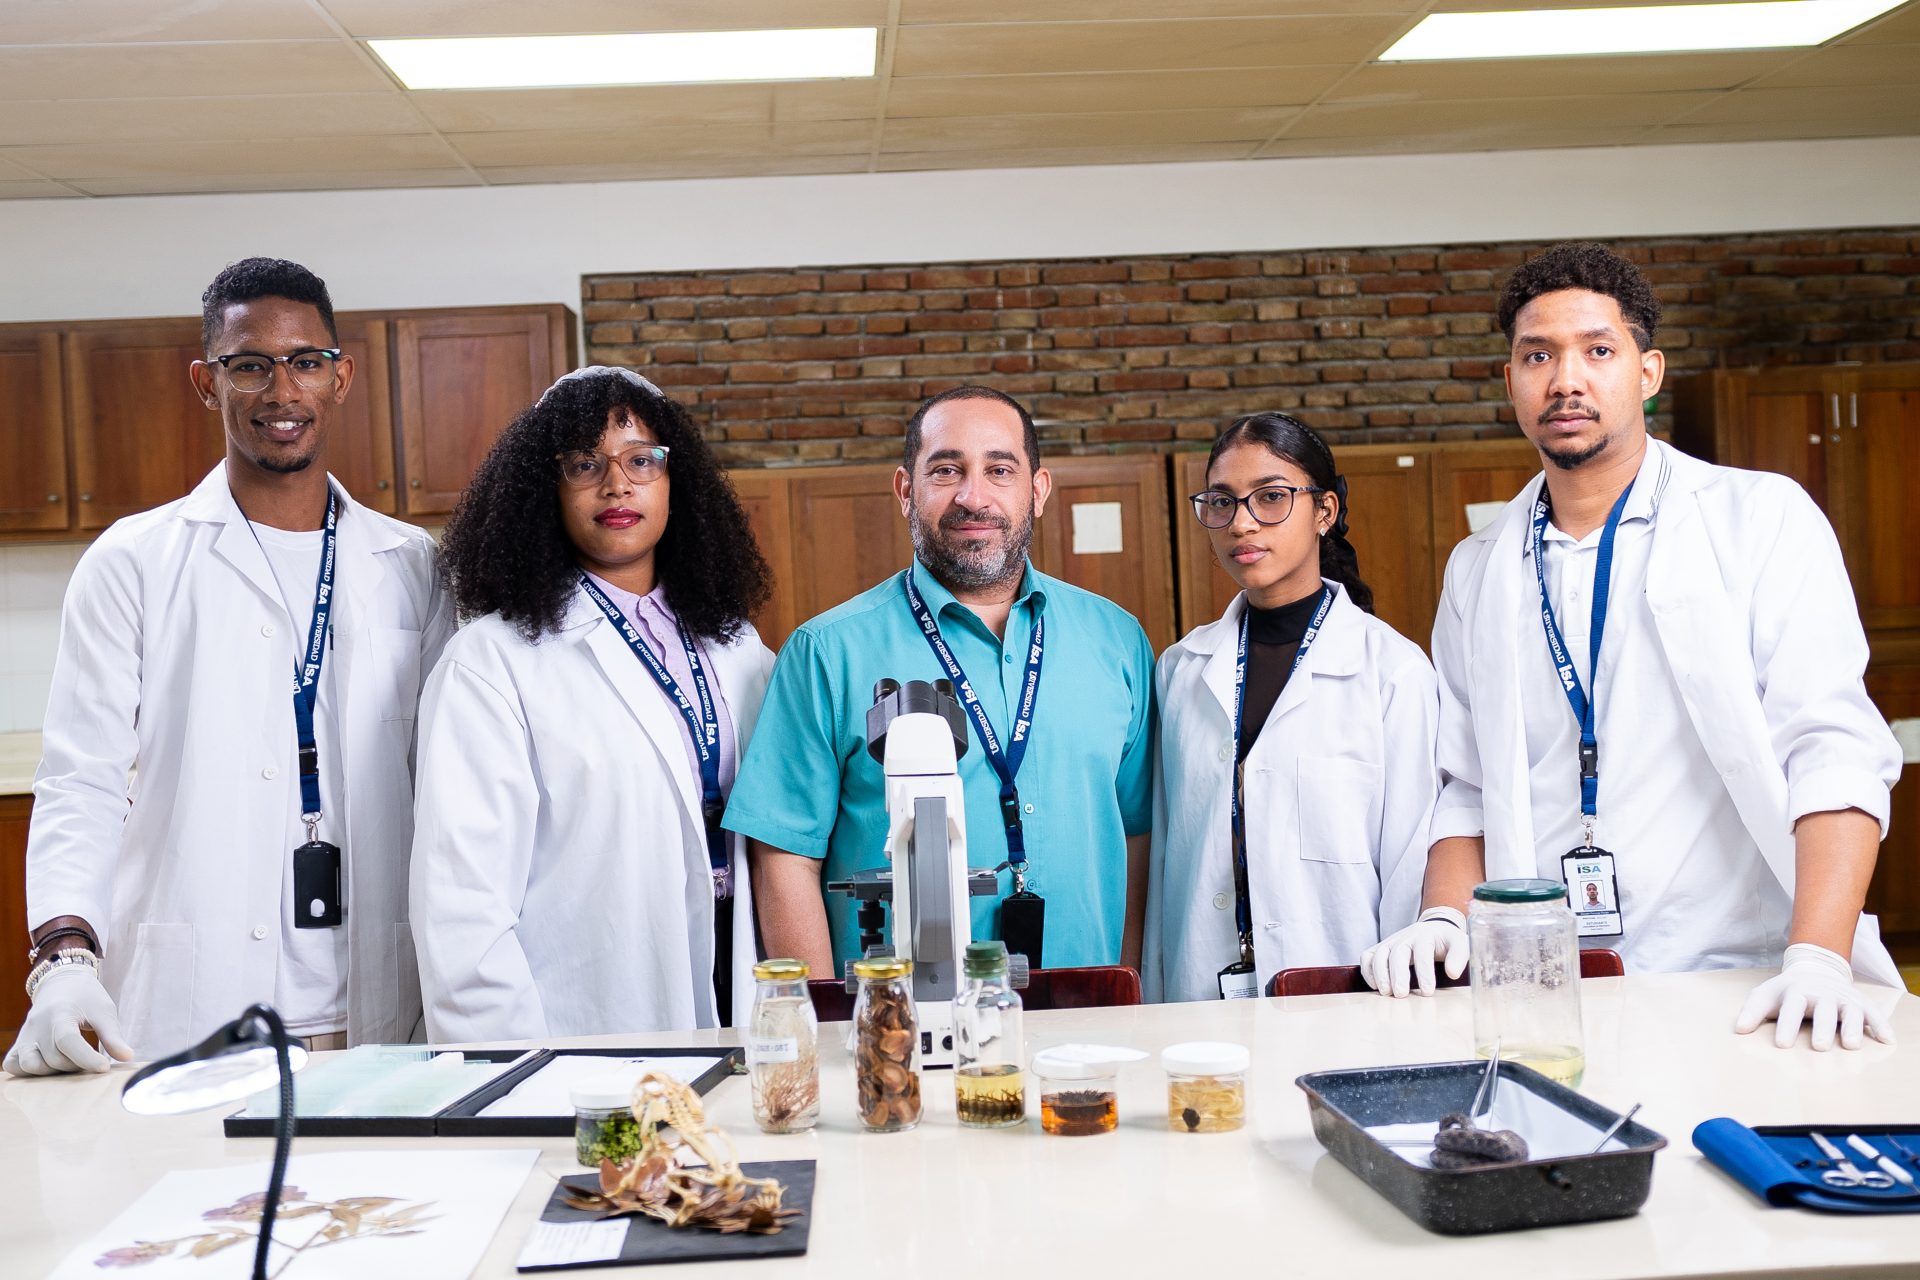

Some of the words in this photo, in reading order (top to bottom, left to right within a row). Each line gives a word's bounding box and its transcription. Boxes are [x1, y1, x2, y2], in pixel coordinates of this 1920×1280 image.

[583, 582, 620, 620] UNIVERSIDAD
[310, 612, 326, 661] UNIVERSIDAD
[932, 634, 961, 679] UNIVERSIDAD
[1543, 608, 1566, 663] UNIVERSIDAD
[636, 643, 672, 685] UNIVERSIDAD
[696, 675, 713, 720] UNIVERSIDAD
[1022, 671, 1038, 718] UNIVERSIDAD
[687, 710, 710, 762] UNIVERSIDAD
[972, 704, 1000, 756] UNIVERSIDAD
